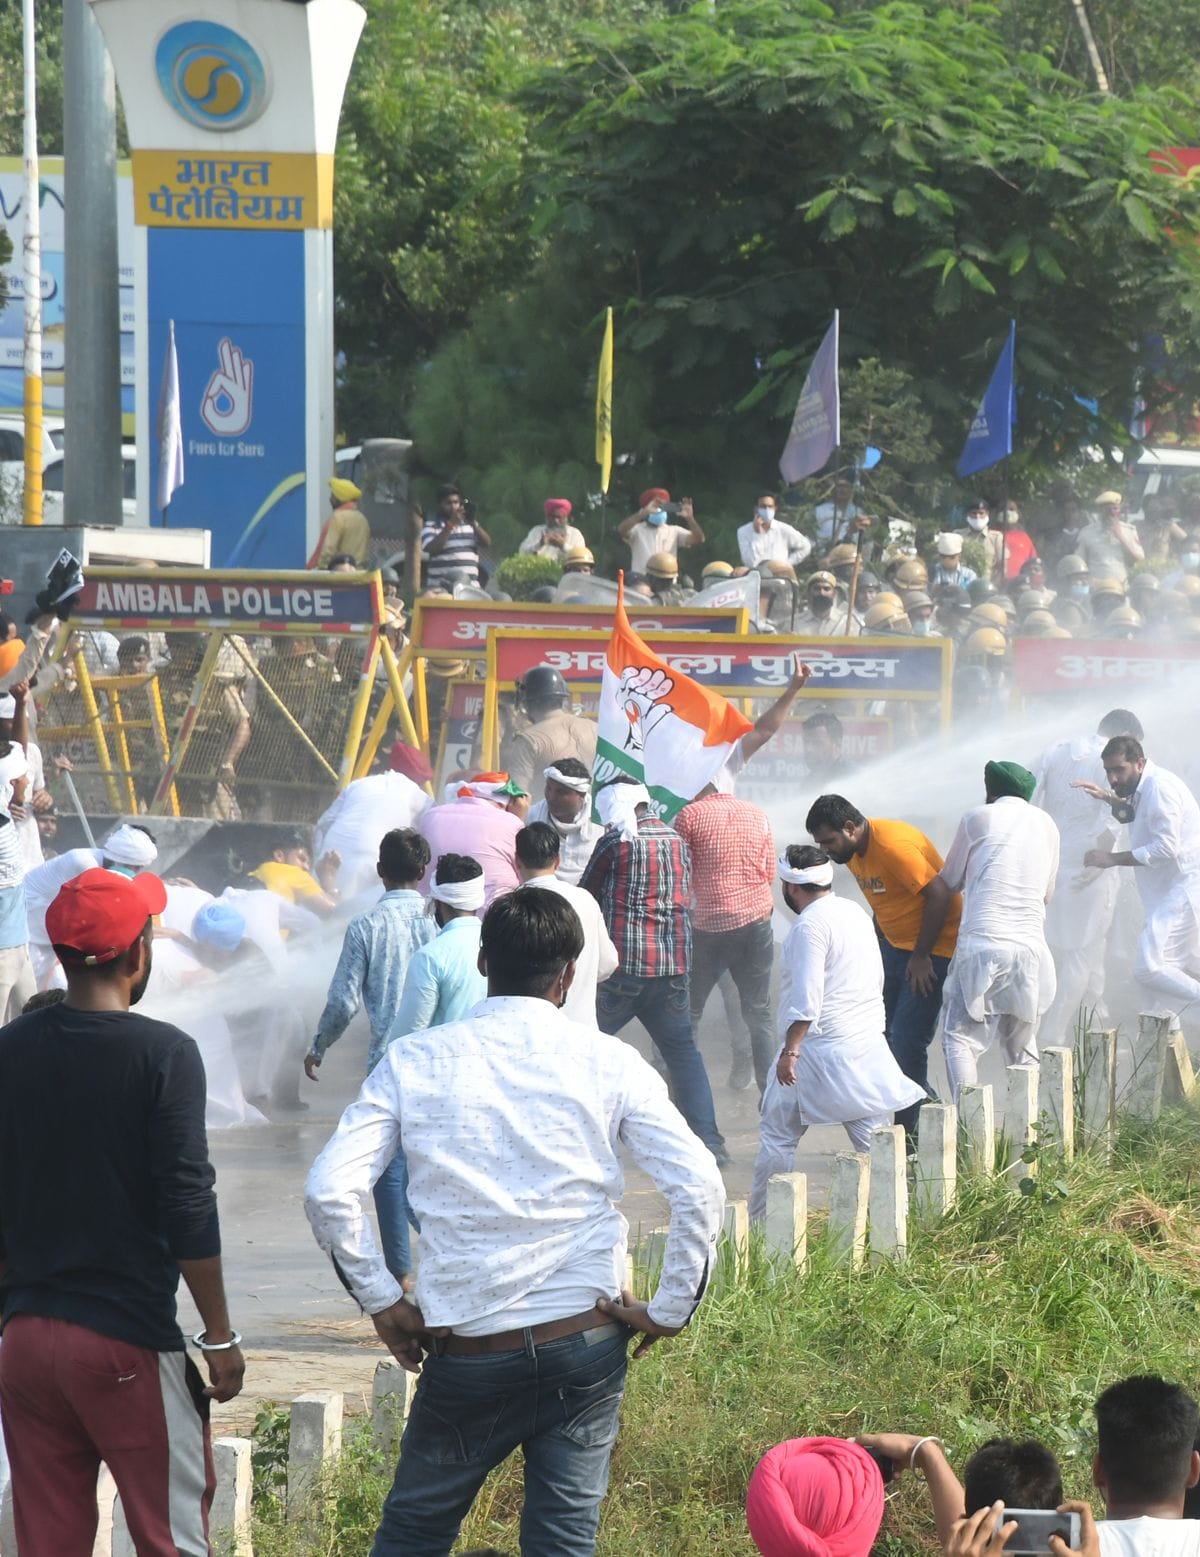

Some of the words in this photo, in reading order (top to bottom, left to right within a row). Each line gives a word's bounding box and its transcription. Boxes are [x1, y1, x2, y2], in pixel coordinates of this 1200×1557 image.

[176, 159, 272, 186] भारत
[237, 441, 265, 457] Sure
[95, 582, 213, 614] AMBALA
[222, 586, 334, 617] POLICE
[748, 648, 900, 686] पुलिस
